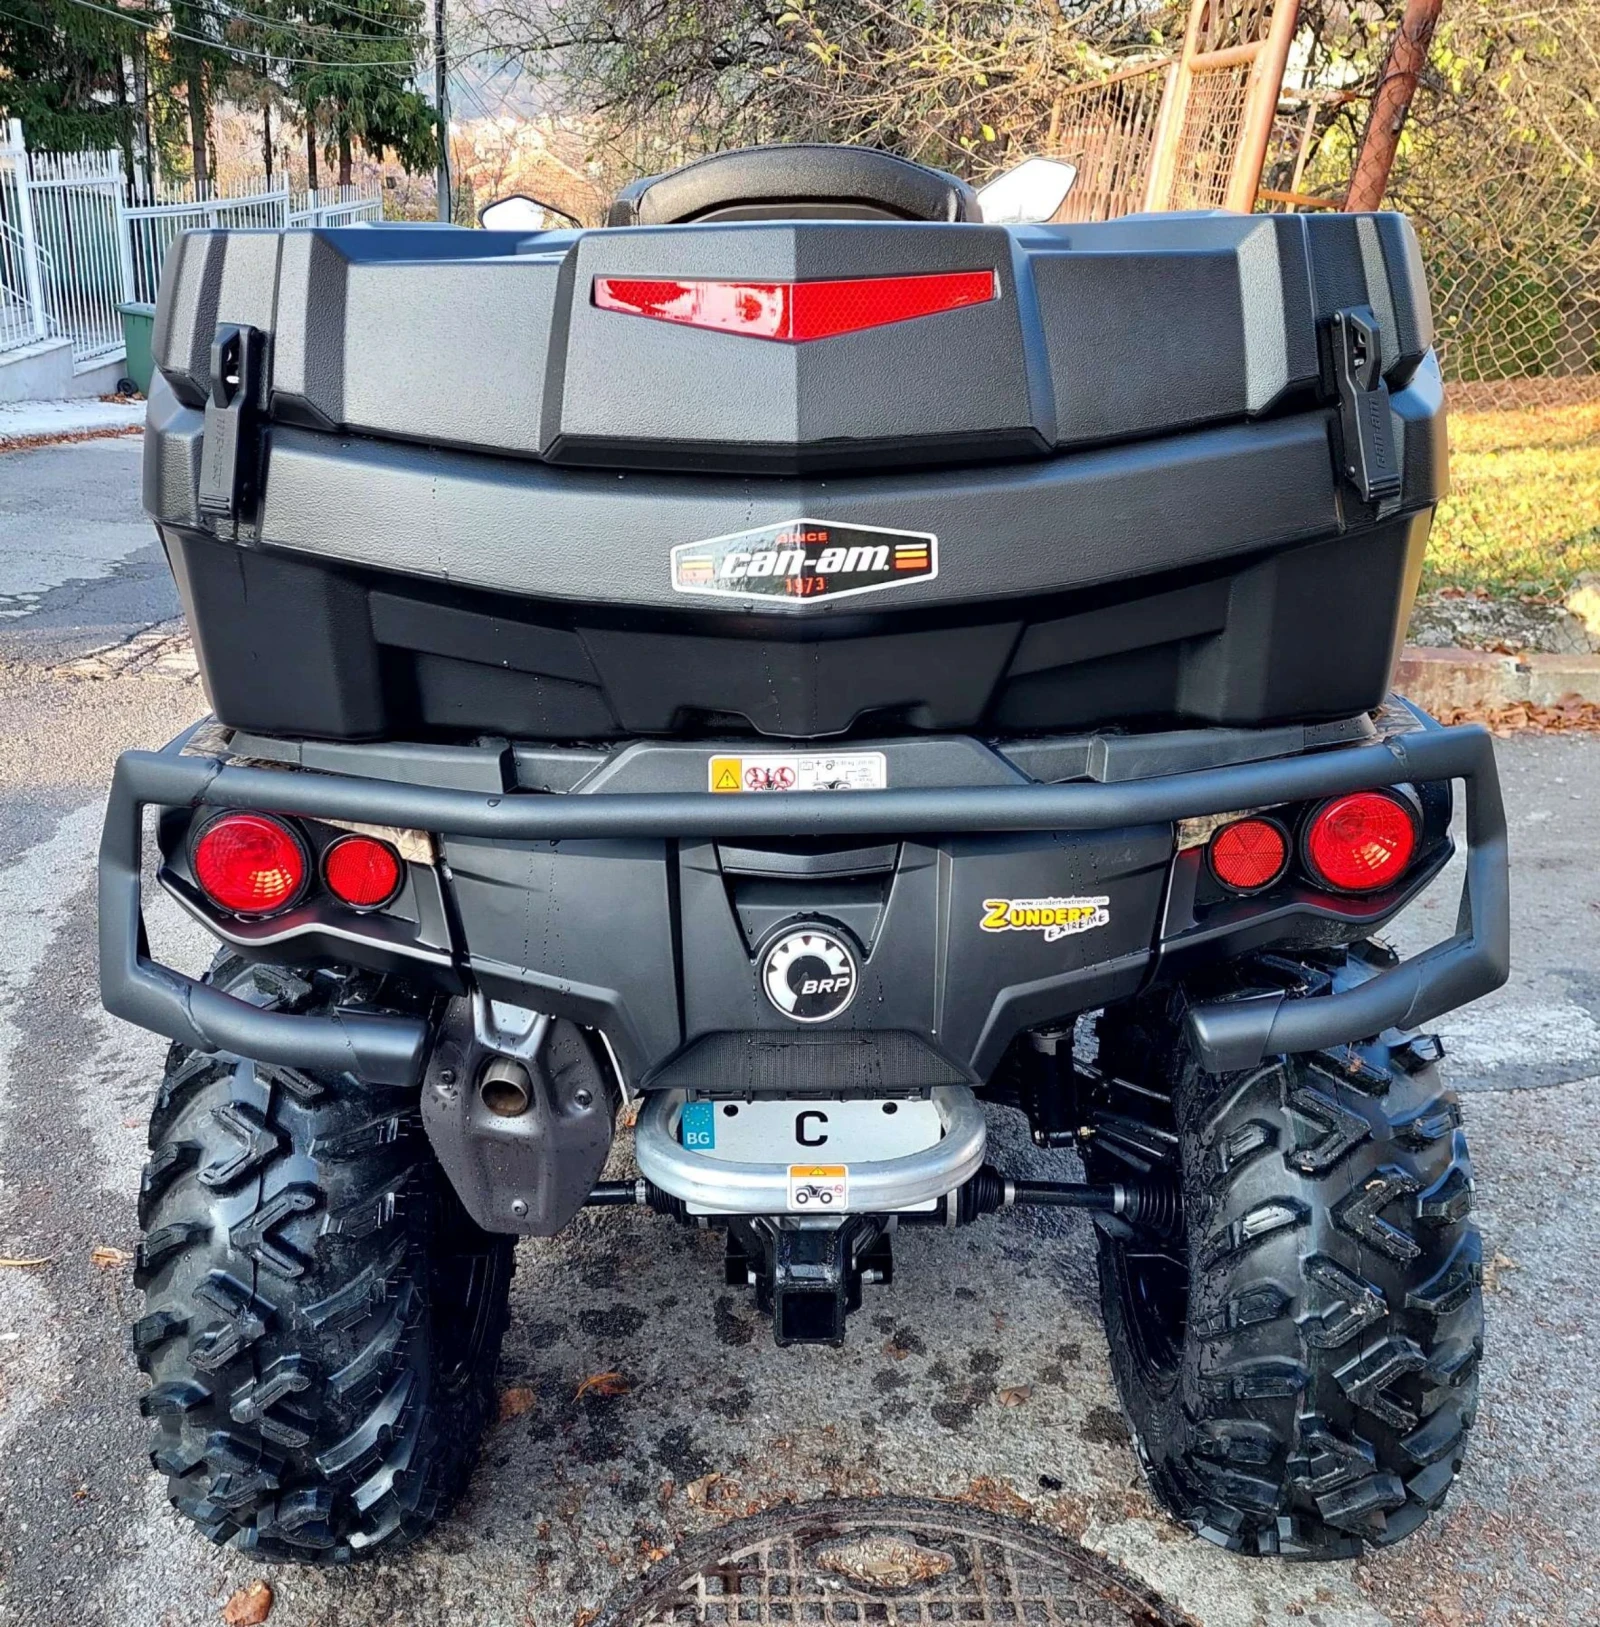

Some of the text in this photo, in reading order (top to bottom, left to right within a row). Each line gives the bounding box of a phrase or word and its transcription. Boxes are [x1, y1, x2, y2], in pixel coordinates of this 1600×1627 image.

[1369, 398, 1387, 469] can-am
[777, 532, 828, 543] SINCE
[785, 577, 825, 593] 1973
[983, 901, 1097, 928] ZUNDERT
[1048, 912, 1106, 938] EXTREME
[801, 977, 850, 995] BRP
[686, 1132, 710, 1145] BG
[795, 1110, 829, 1147] C
